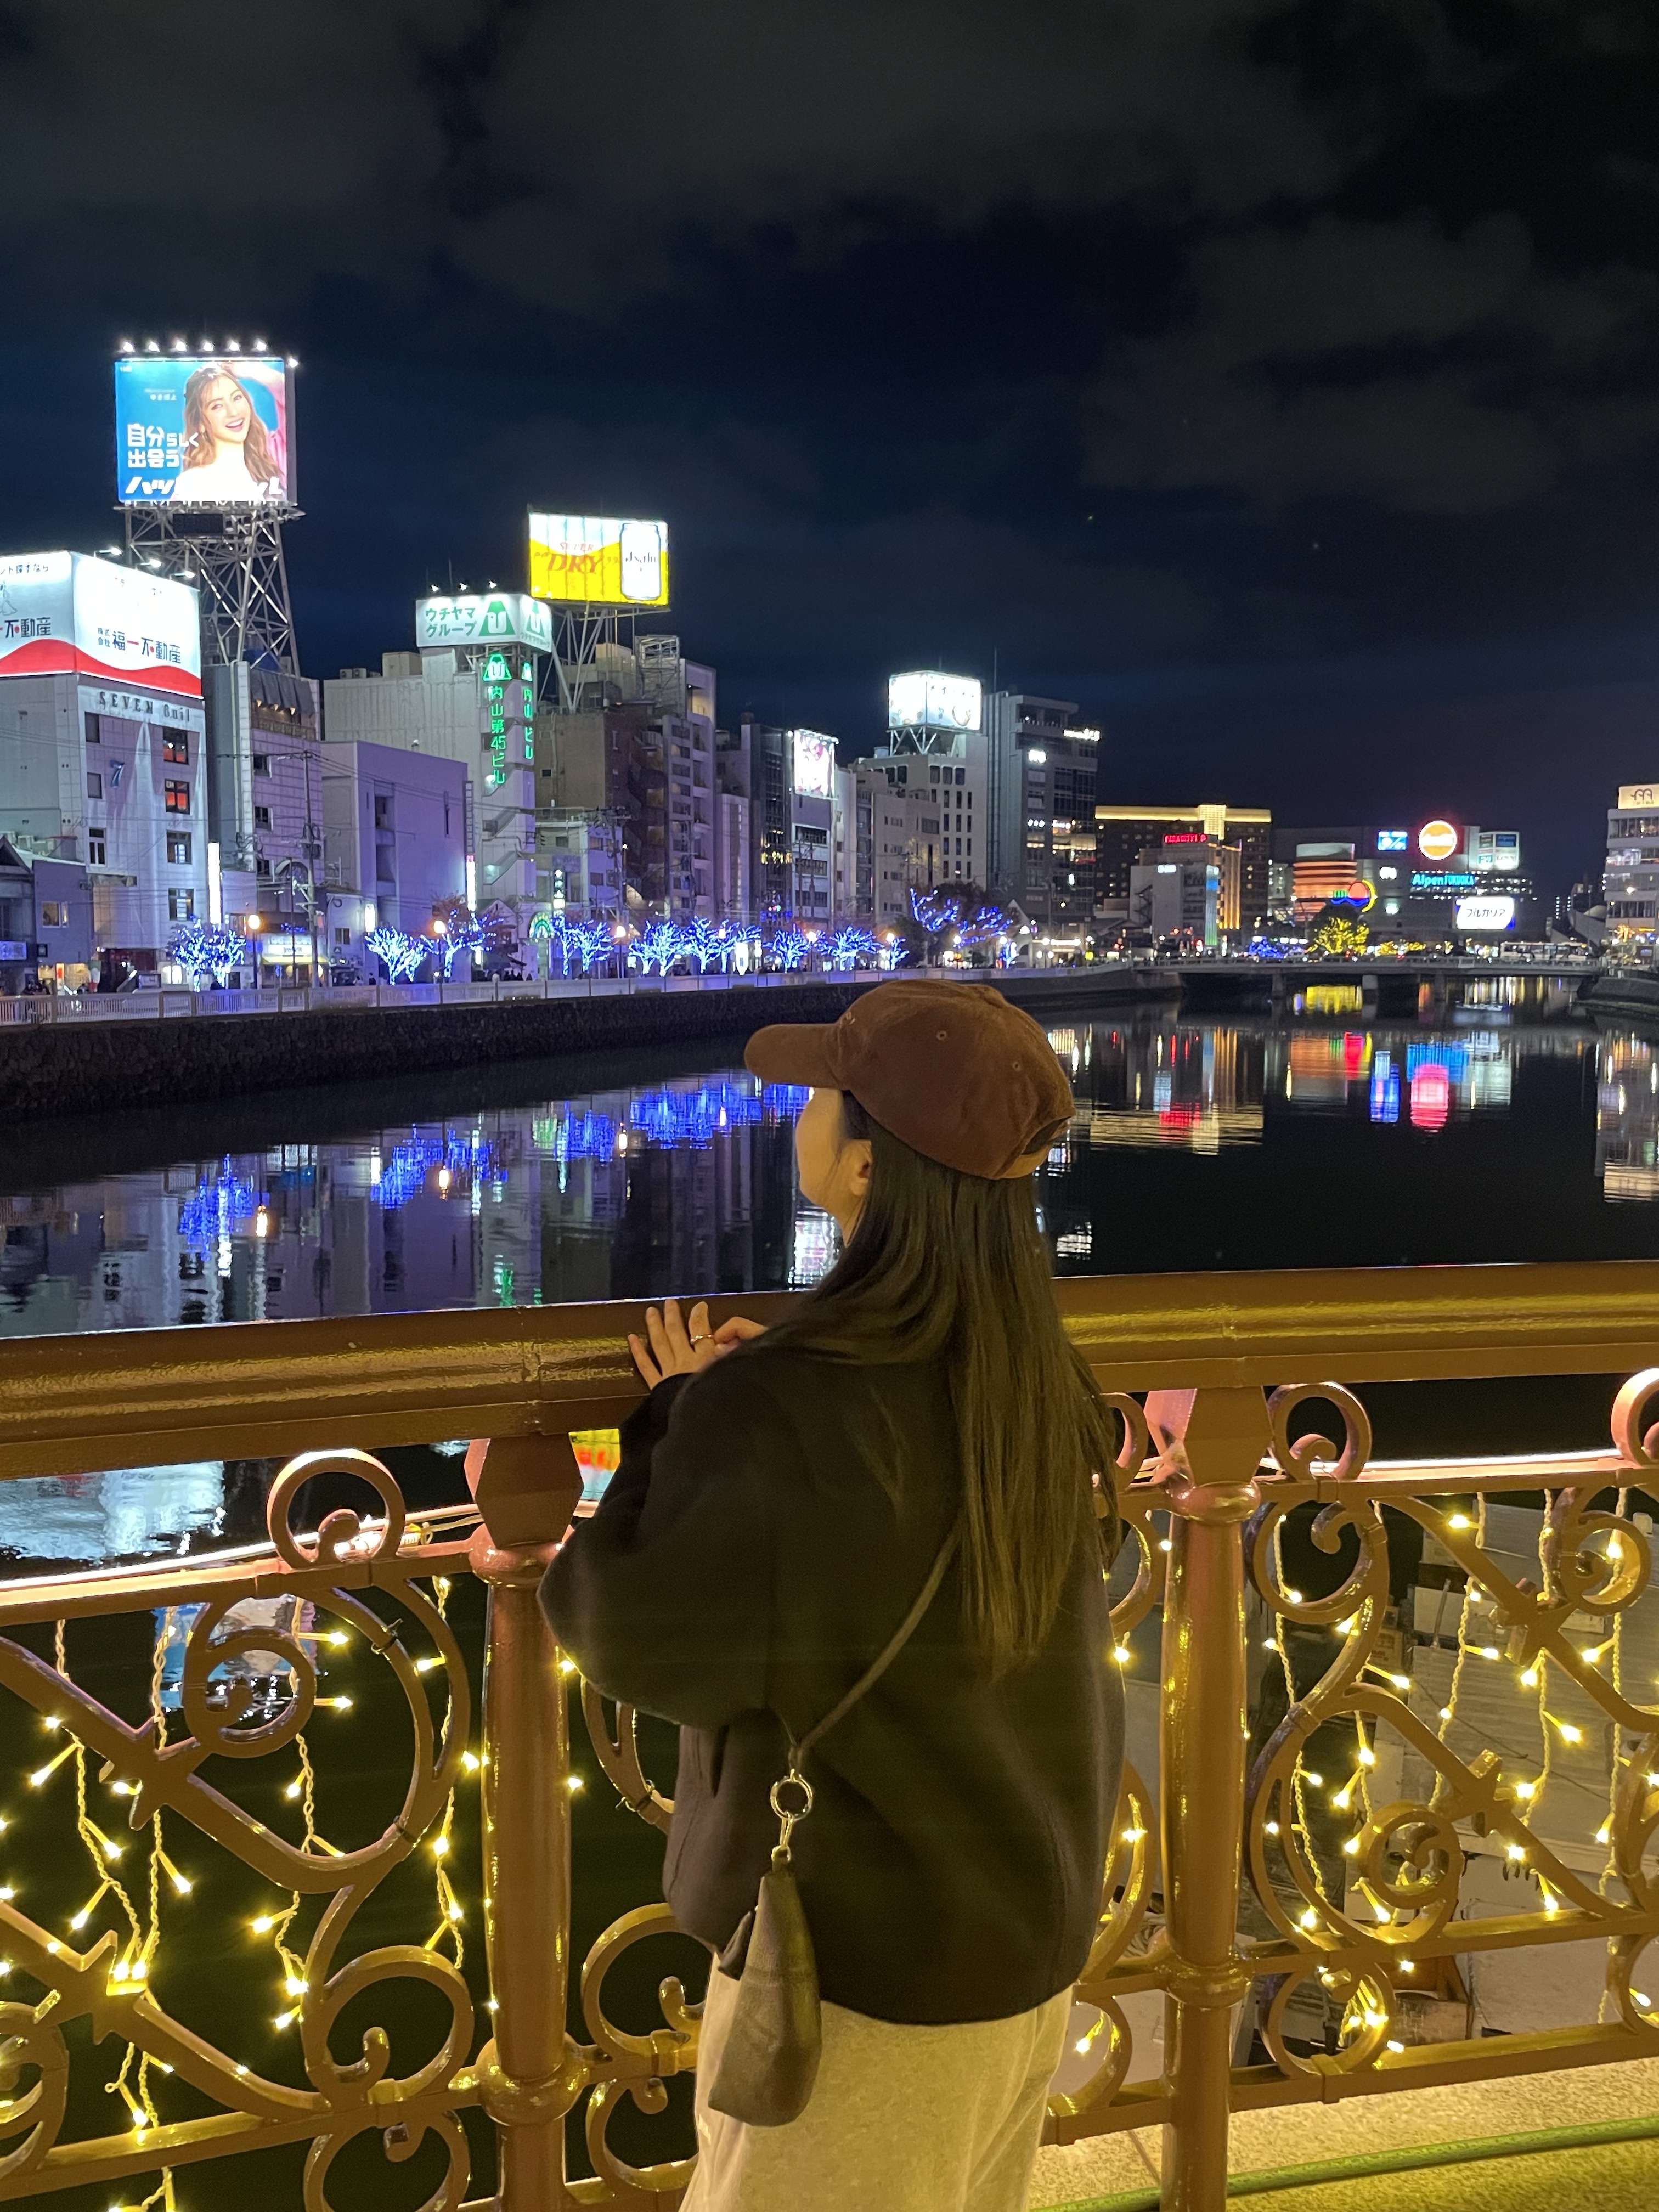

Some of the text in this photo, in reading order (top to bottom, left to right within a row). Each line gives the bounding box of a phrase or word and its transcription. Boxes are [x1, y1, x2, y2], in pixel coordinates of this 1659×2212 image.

[127, 423, 199, 447] 自分らしく
[128, 448, 180, 469] 出会う
[426, 606, 476, 622] ウチヤマ
[0, 617, 52, 638] 不動産
[426, 620, 477, 638] グループ
[112, 631, 181, 664] 福一不動産
[99, 691, 153, 714] SEVEN
[490, 686, 506, 784] 内山第45ビル
[1412, 874, 1444, 888] Alpen
